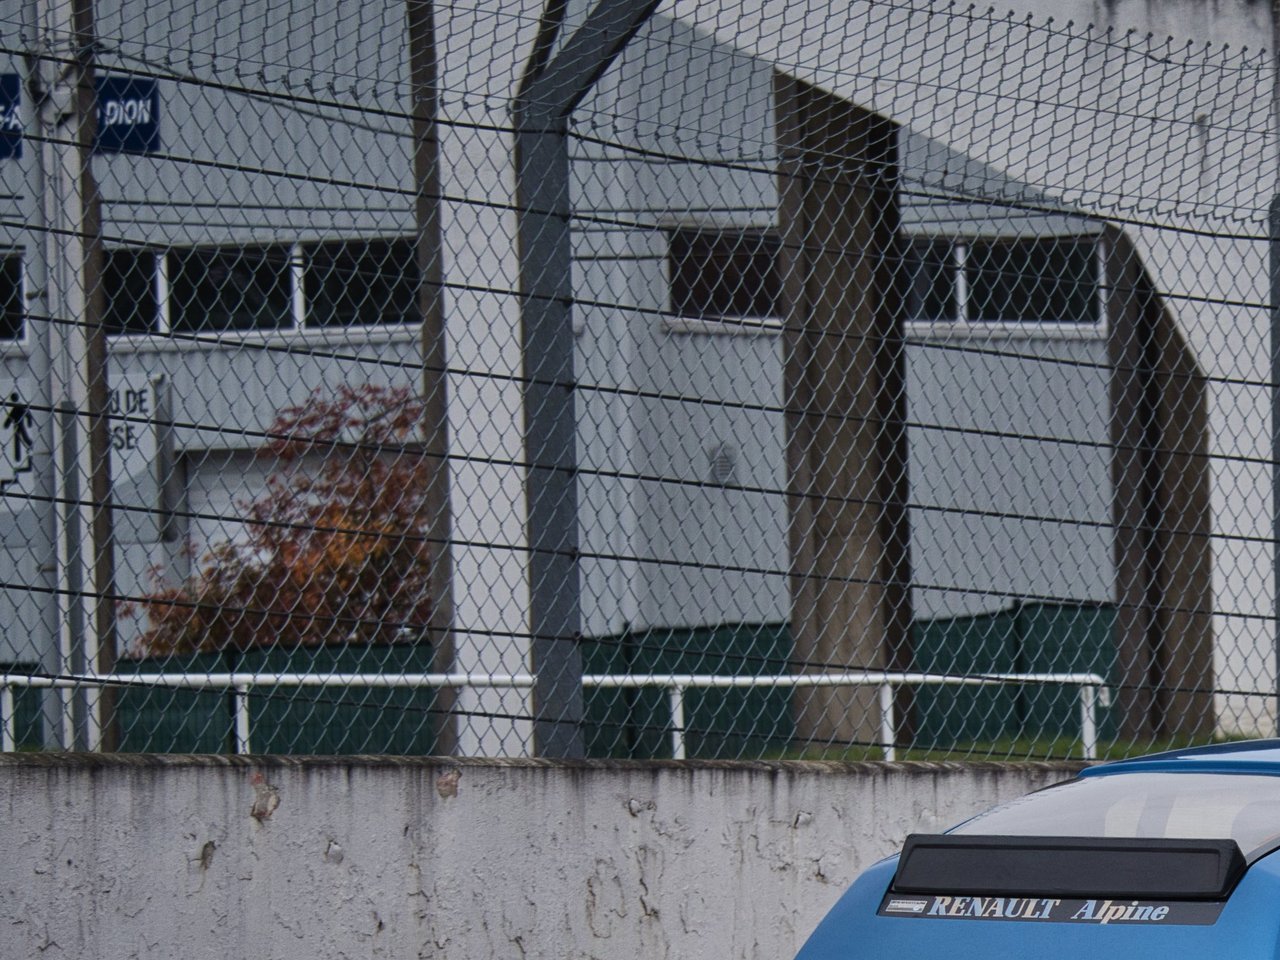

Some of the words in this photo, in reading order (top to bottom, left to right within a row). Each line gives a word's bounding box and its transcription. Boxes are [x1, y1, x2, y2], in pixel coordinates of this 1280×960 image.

[125, 388, 148, 413] DE
[926, 895, 1061, 919] RENAULT
[1071, 900, 1170, 925] Alpine
